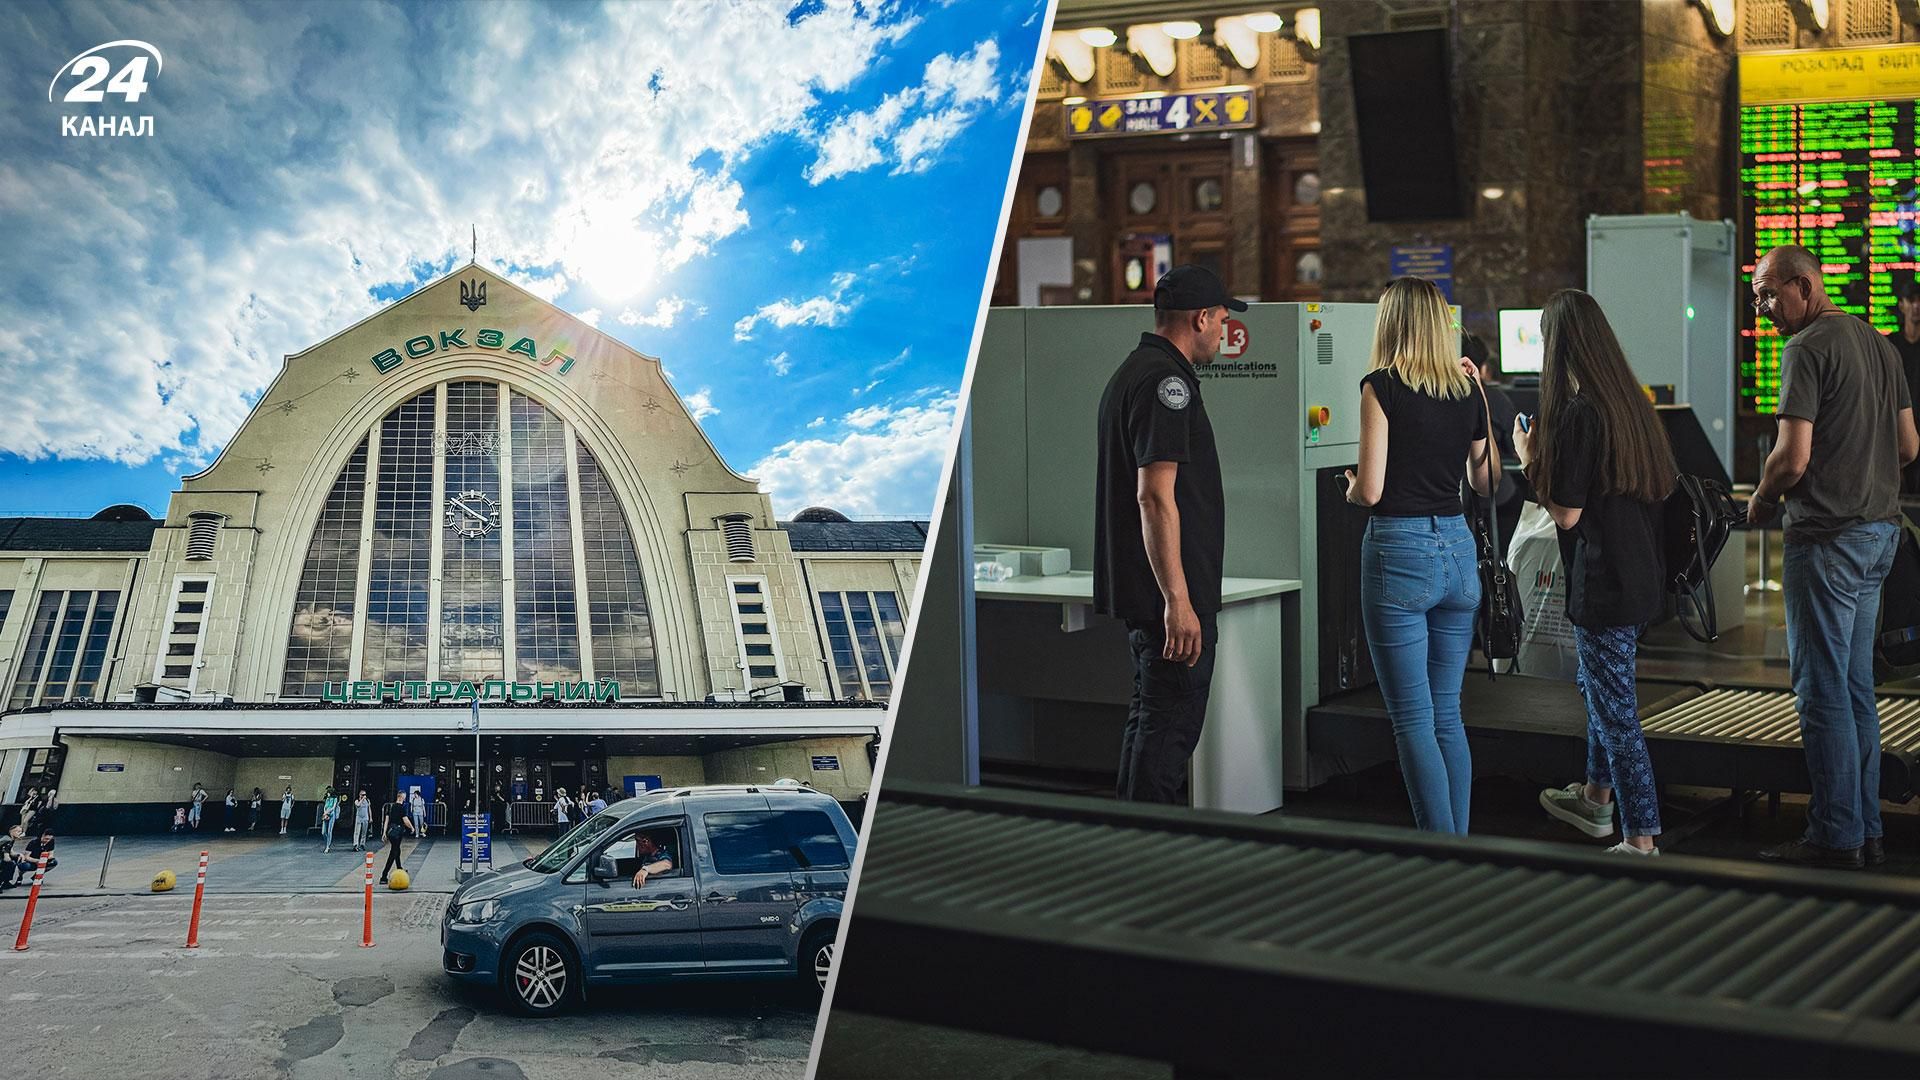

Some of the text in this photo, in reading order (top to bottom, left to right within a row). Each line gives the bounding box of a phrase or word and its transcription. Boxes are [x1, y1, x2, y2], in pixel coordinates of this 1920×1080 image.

[1125, 96, 1191, 129] ЗАЛ 4
[370, 327, 577, 376] ВОКЗАЛ
[1193, 361, 1277, 371] ommunications
[321, 677, 622, 702] ЦЕНТРАЛЬНИЙ
